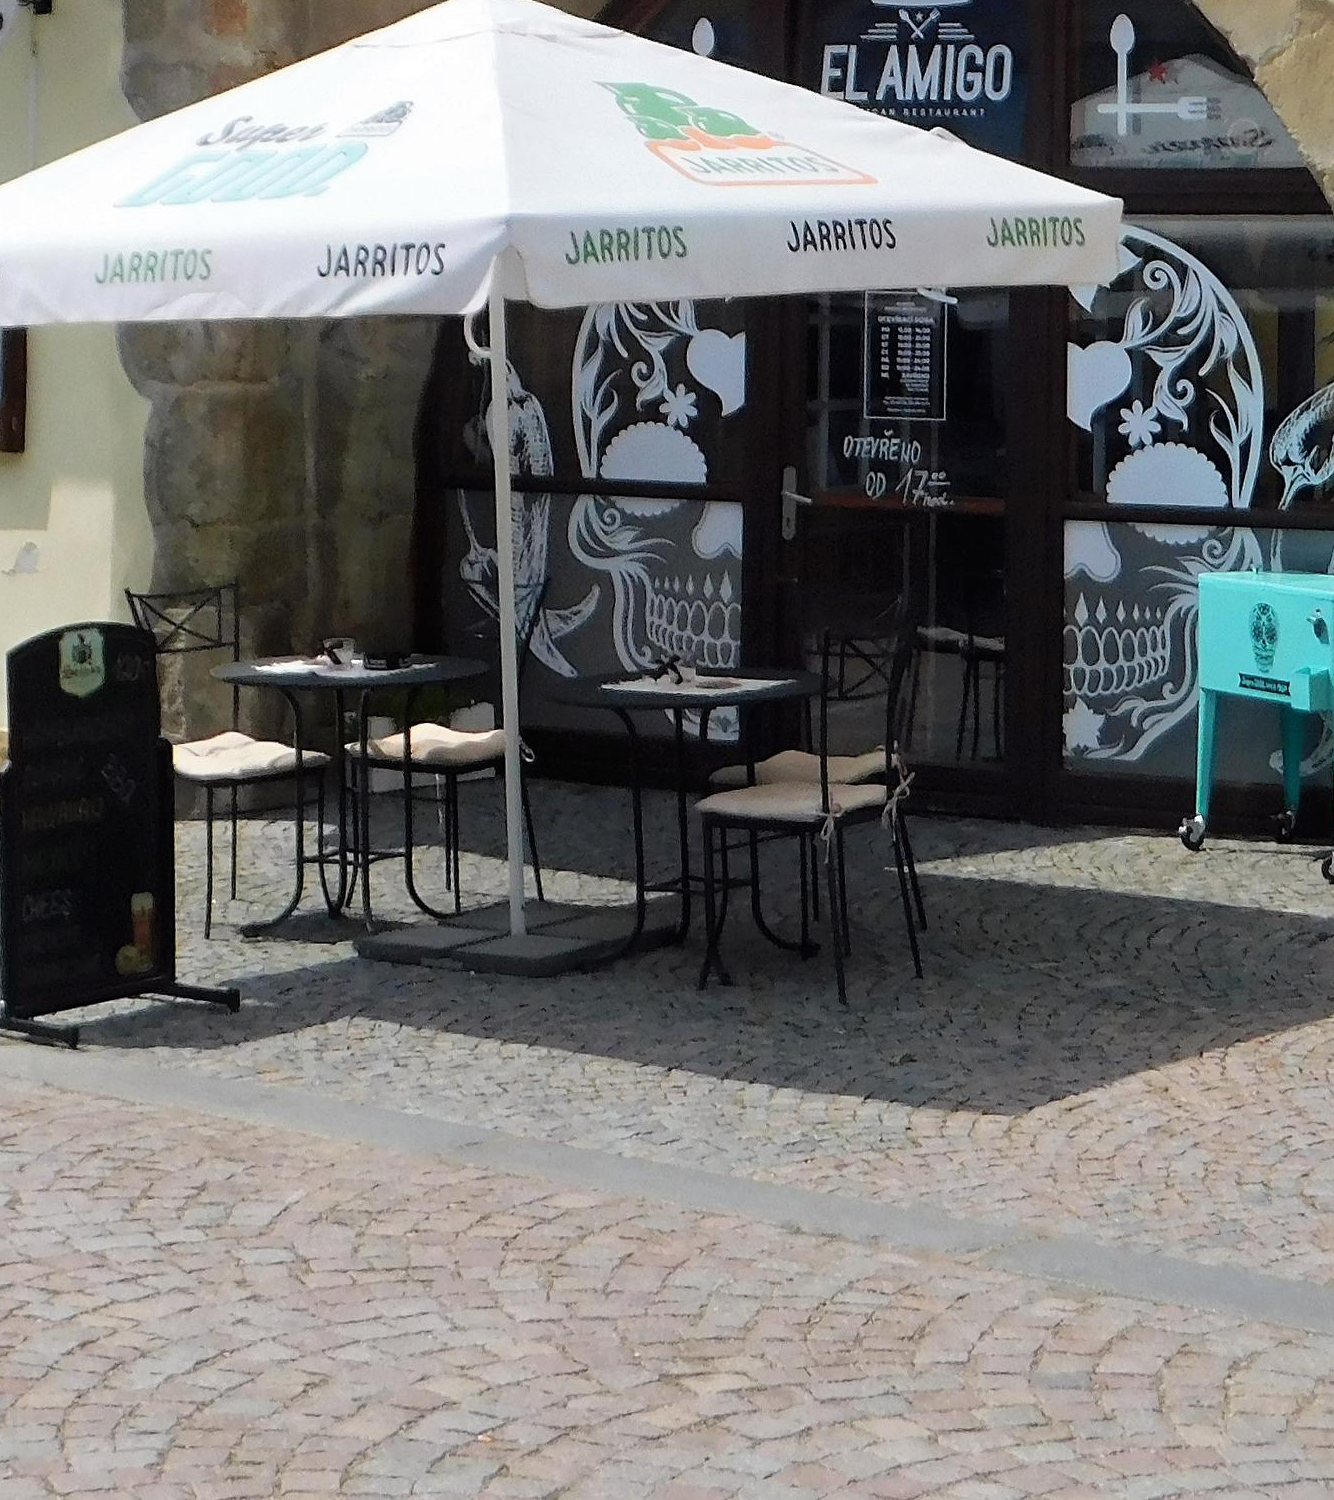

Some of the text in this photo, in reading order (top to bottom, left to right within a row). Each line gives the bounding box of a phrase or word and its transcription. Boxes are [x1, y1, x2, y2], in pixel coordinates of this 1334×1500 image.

[820, 43, 1013, 102] EL AMIGO
[903, 107, 986, 117] RESTAURANT
[195, 115, 329, 152] Super
[680, 156, 839, 174] JARRITOS
[565, 225, 688, 265] JARRITOS
[787, 218, 897, 252] JARRITOS
[986, 216, 1086, 248] JARRITOS
[94, 249, 213, 284] JARRITOS
[317, 242, 446, 278] JARRITOS
[843, 429, 922, 463] OTEVŘENO
[865, 471, 886, 500] OD
